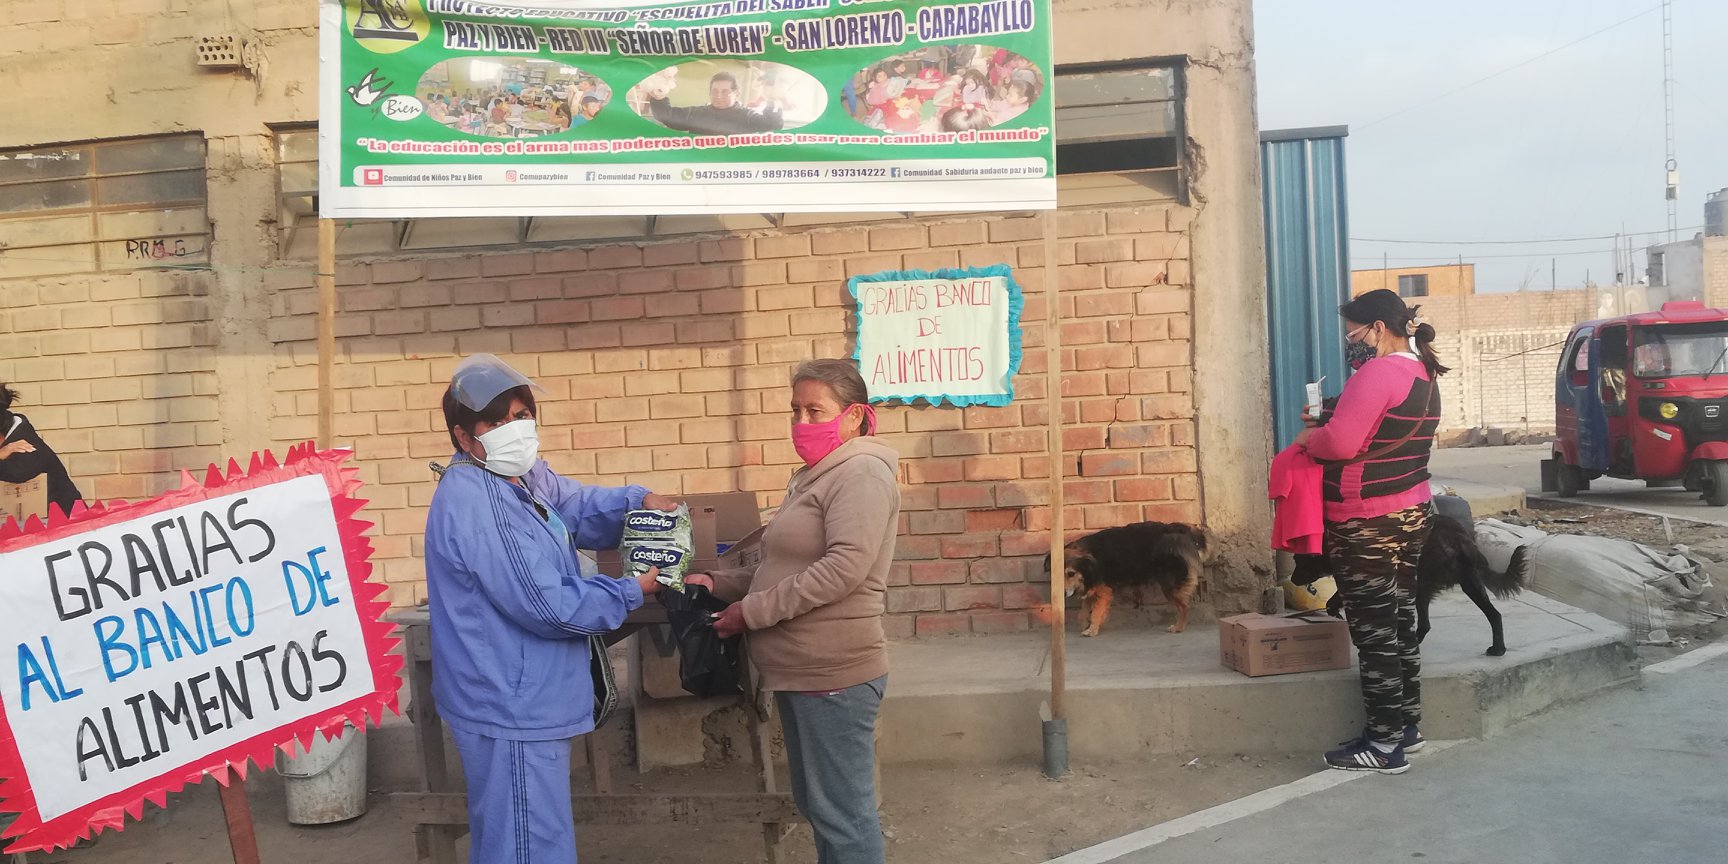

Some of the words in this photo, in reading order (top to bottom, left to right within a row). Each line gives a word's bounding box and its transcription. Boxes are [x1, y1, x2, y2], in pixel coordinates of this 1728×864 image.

[444, 21, 478, 48] PAZ
[477, 24, 490, 49] Y
[492, 25, 537, 50] BIEN
[548, 28, 584, 51] RED
[608, 24, 677, 54] “SEÑOR
[678, 28, 705, 54] DE
[704, 24, 769, 54] LUREN”
[784, 18, 821, 49] SAN
[825, 11, 902, 46] LORENZO
[919, 0, 1032, 40] CARABAYLLO
[386, 99, 420, 115] Bien
[358, 140, 387, 151] “La
[391, 141, 479, 153] educación
[483, 145, 502, 153] es
[506, 140, 522, 153] el
[526, 143, 569, 152] arma
[573, 141, 608, 151] mas
[612, 138, 691, 151] poderosa
[695, 136, 726, 147] que
[730, 133, 793, 147] puedes
[797, 134, 836, 144] usar
[840, 135, 879, 144] para
[883, 132, 954, 144] cambiar
[959, 130, 975, 142] el
[979, 128, 1047, 141] mundo”
[384, 174, 420, 182] Comunidad
[422, 173, 430, 182] de
[431, 172, 449, 182] Niños
[451, 172, 462, 181] Paz
[468, 172, 483, 181] Bien
[519, 172, 568, 182] Comupazybien
[597, 172, 635, 180] Comunidad
[639, 172, 650, 180] Paz
[656, 172, 671, 180] Bien
[695, 169, 752, 180] 947593985
[762, 169, 820, 179] 989783664
[831, 167, 886, 178] 937314222
[903, 168, 943, 177] Comunidad
[979, 167, 1009, 175] andante
[1009, 168, 1022, 176] paz
[864, 283, 928, 316] GRACIAS
[934, 280, 991, 308] BANCO
[916, 315, 942, 338] DE
[871, 344, 984, 386] ALIMENTOS
[44, 497, 277, 622] GRACIAS
[633, 550, 677, 563] costeño
[17, 635, 84, 711] AL
[93, 576, 256, 683] BANCO
[281, 546, 340, 617] DE
[75, 630, 348, 782] ALIMENTOS
